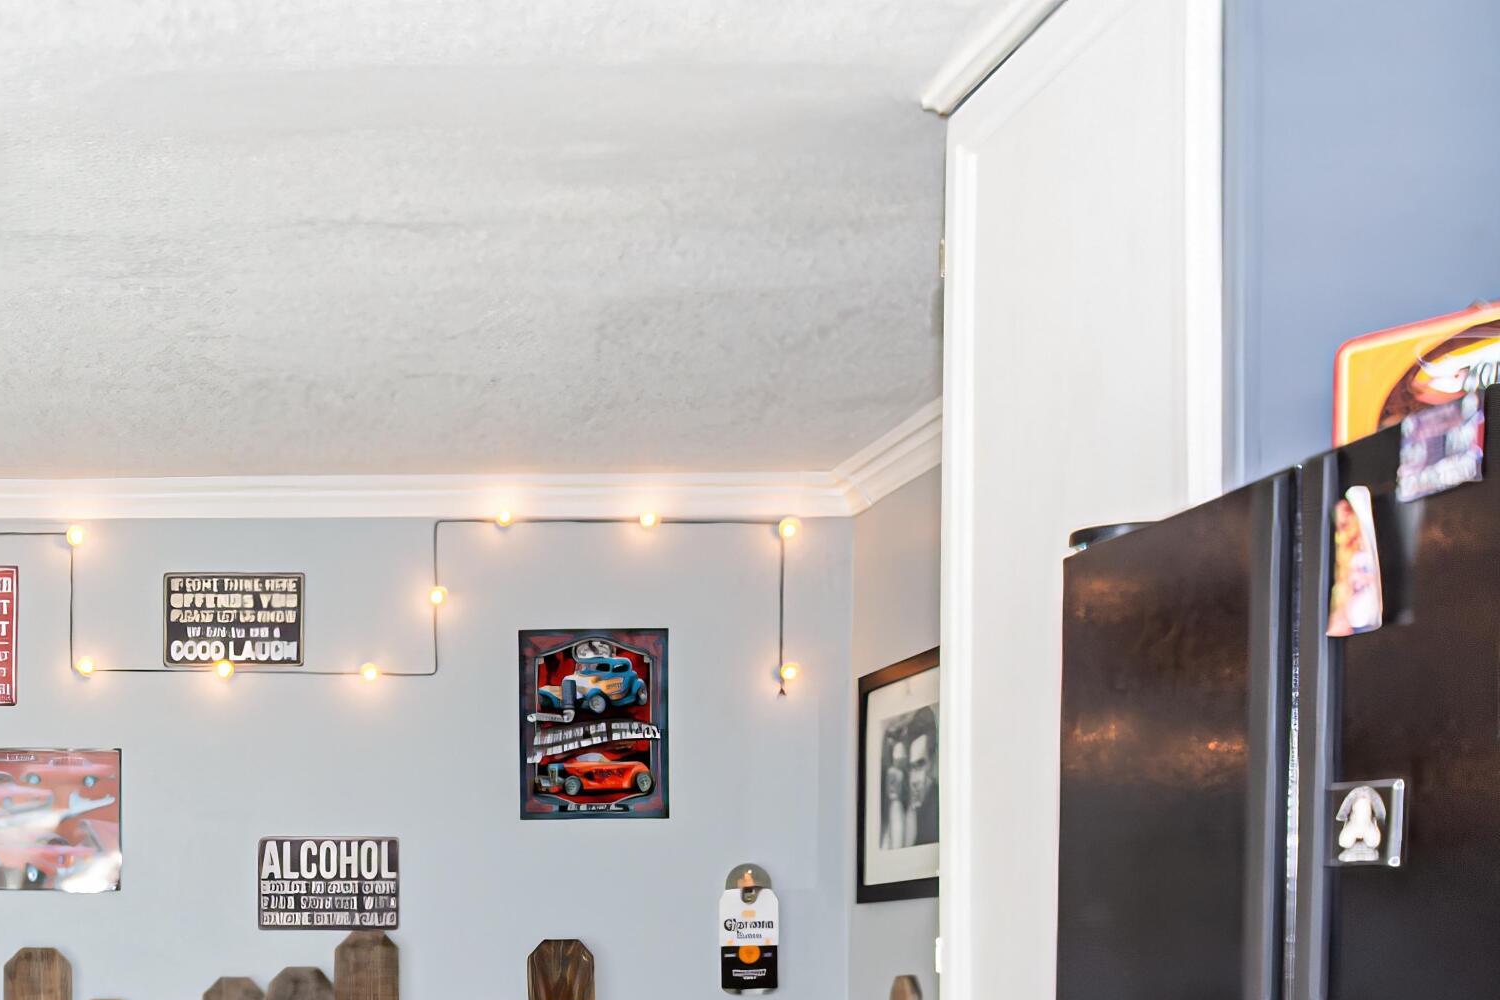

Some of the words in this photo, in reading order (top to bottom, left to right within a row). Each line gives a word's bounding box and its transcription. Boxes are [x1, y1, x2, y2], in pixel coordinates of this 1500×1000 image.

[170, 593, 255, 609] OFFENDS
[259, 593, 298, 608] YOU
[170, 640, 226, 662] GOOD
[228, 640, 298, 662] LAUGH
[261, 840, 397, 879] ALCOHOL
